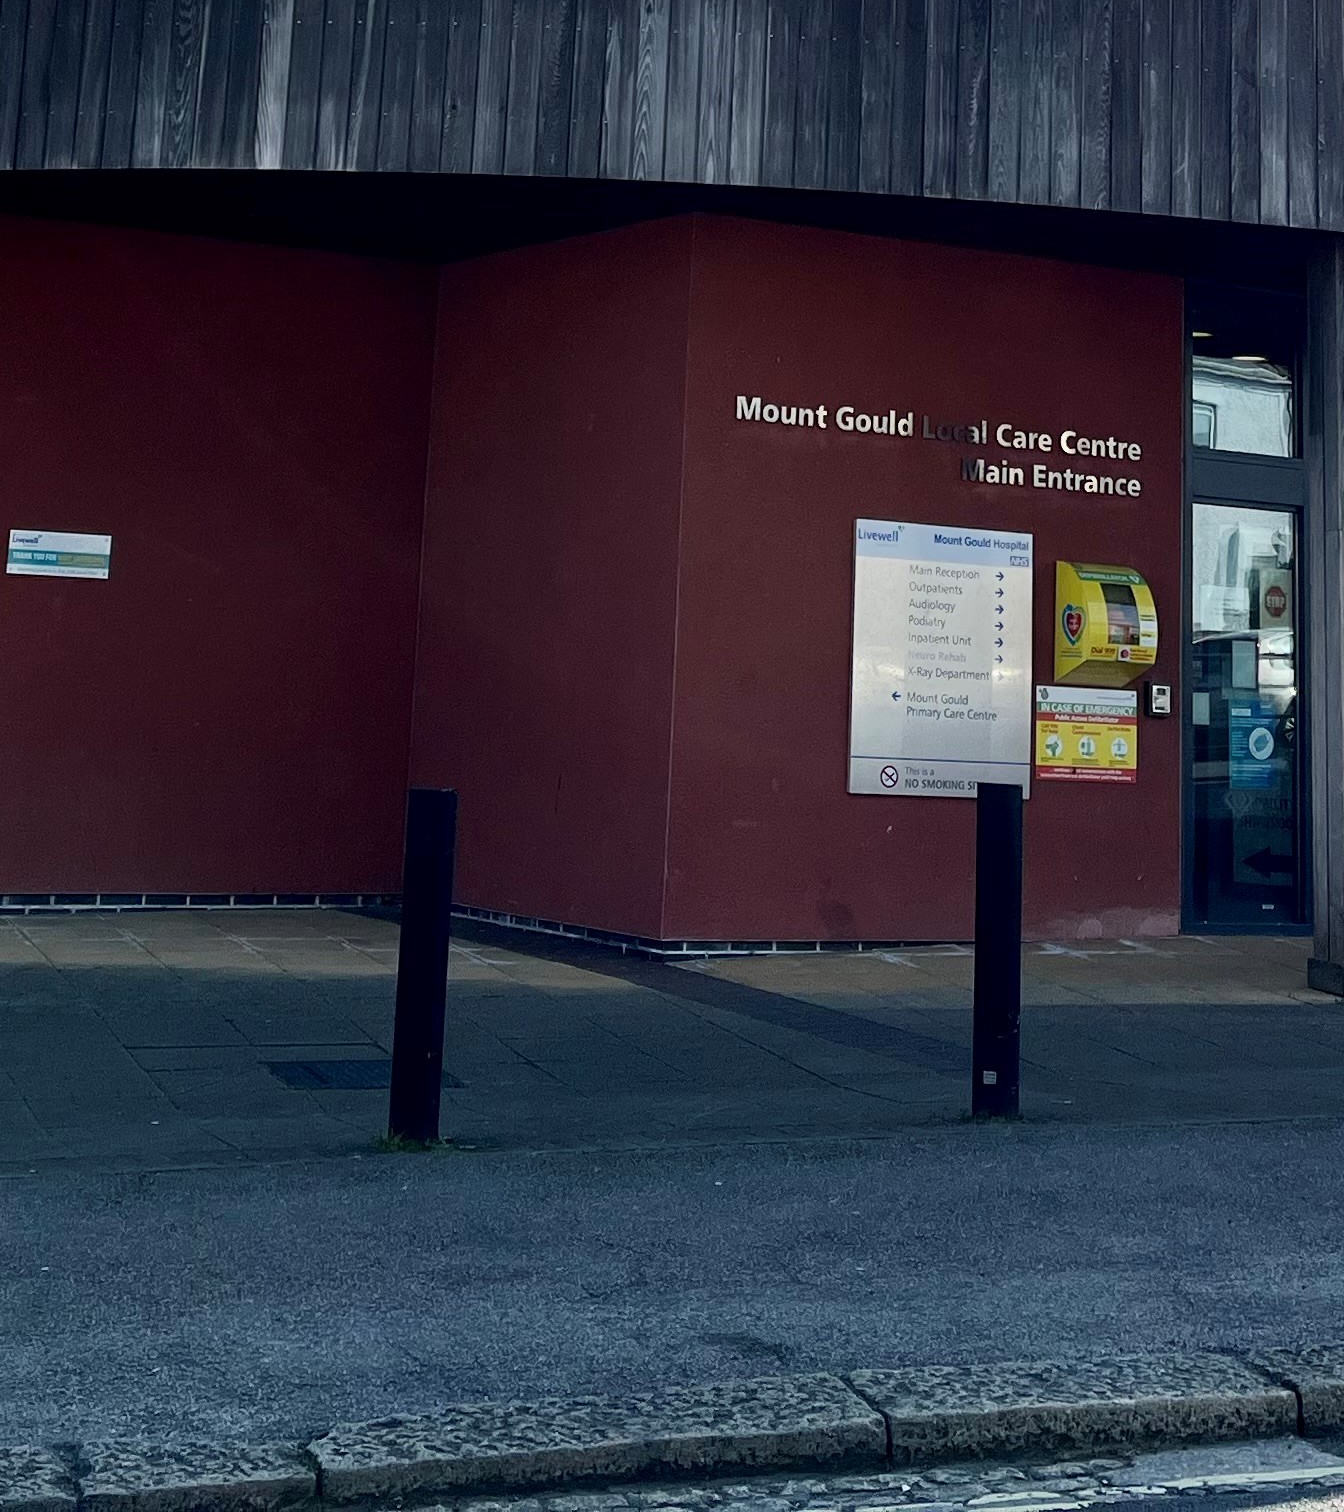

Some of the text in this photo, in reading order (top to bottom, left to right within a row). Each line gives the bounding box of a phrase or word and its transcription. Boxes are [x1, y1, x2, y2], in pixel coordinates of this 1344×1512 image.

[735, 395, 1142, 461] Mount Gould Local Care Centre
[962, 455, 1142, 497] Main Entrance
[858, 528, 898, 542] Livewell
[933, 534, 1029, 552] Mount Gould Hospital
[910, 565, 980, 581] Main Reception
[909, 581, 963, 596] Outpatients
[909, 598, 955, 613] Audiology
[1266, 595, 1285, 608] STOP
[908, 615, 946, 630] Podiatry
[908, 633, 972, 646] Inpatient Unit
[908, 651, 967, 662] Neuro Rehab
[908, 667, 990, 681] X-Ray Department
[907, 692, 969, 705] Mount Gould
[906, 706, 997, 721] Primary Care Centre
[1051, 703, 1072, 713] CASE
[1073, 705, 1084, 713] OF
[1085, 705, 1134, 716] EMERGENCY
[906, 767, 920, 775] This
[905, 778, 919, 788] NO
[921, 779, 965, 790] SMOKING
